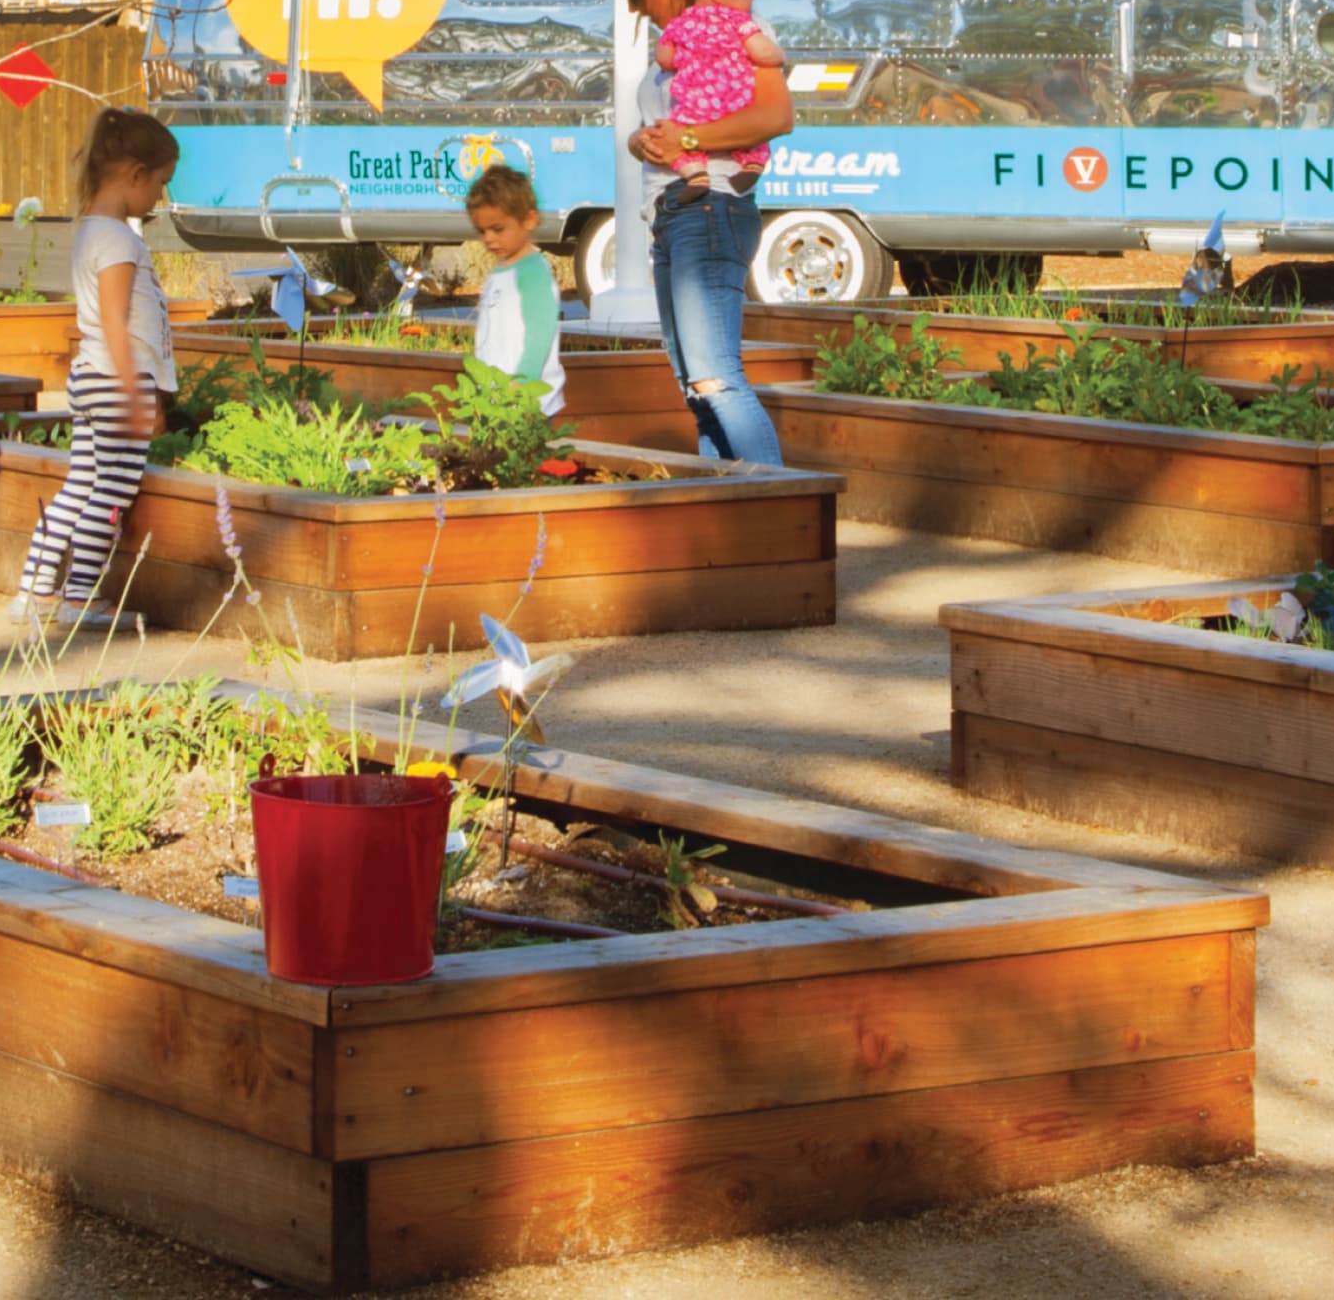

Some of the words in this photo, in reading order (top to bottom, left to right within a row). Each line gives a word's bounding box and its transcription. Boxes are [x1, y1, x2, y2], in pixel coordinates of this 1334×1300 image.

[349, 150, 402, 179] Great
[409, 150, 465, 182] Park
[763, 146, 901, 177] tream
